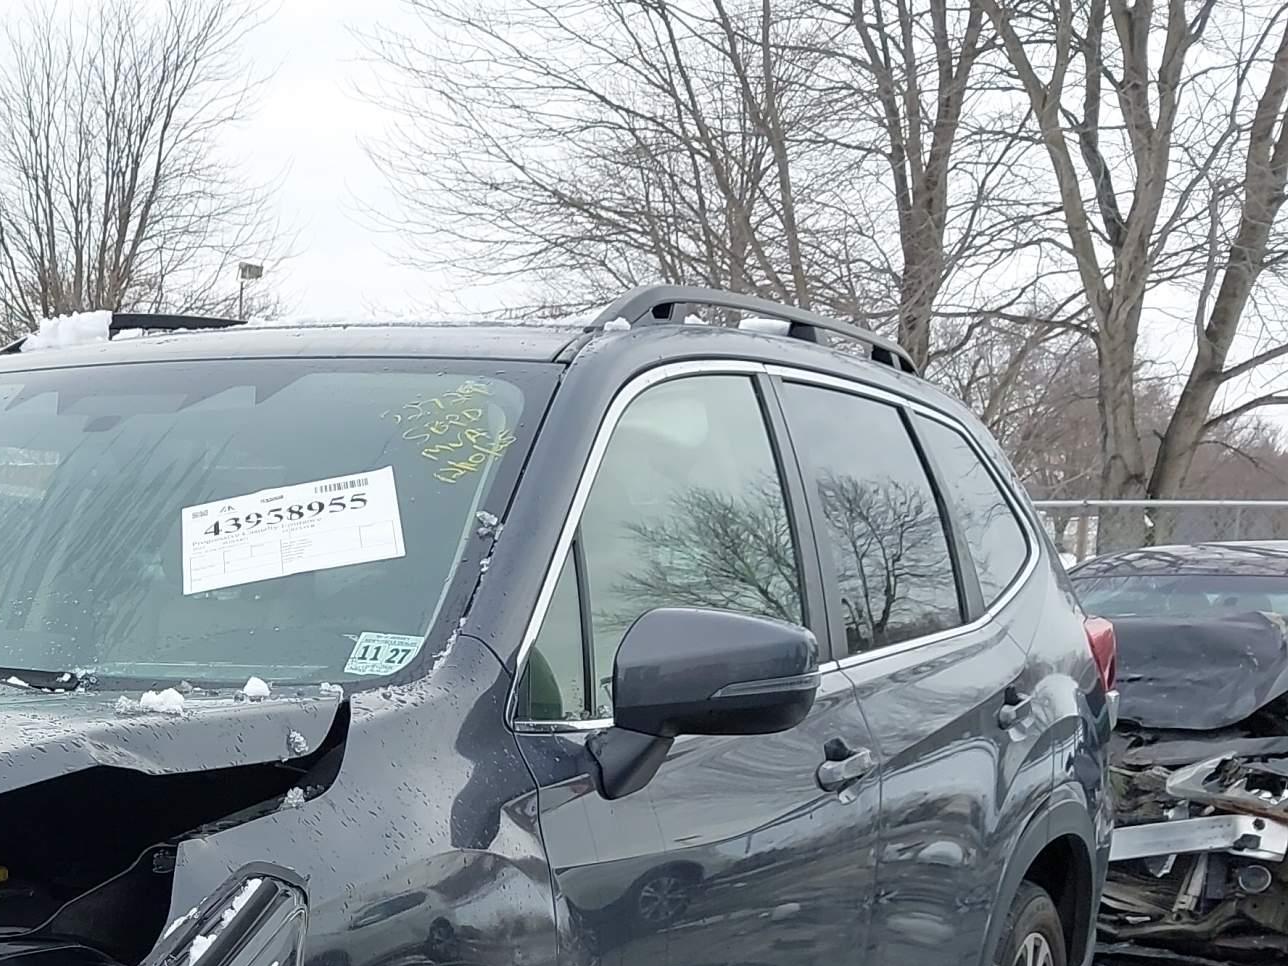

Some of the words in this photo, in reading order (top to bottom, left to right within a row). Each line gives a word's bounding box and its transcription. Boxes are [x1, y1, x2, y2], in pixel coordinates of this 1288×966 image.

[203, 492, 369, 537] 43958955
[357, 644, 382, 661] 11
[384, 647, 412, 665] 27
